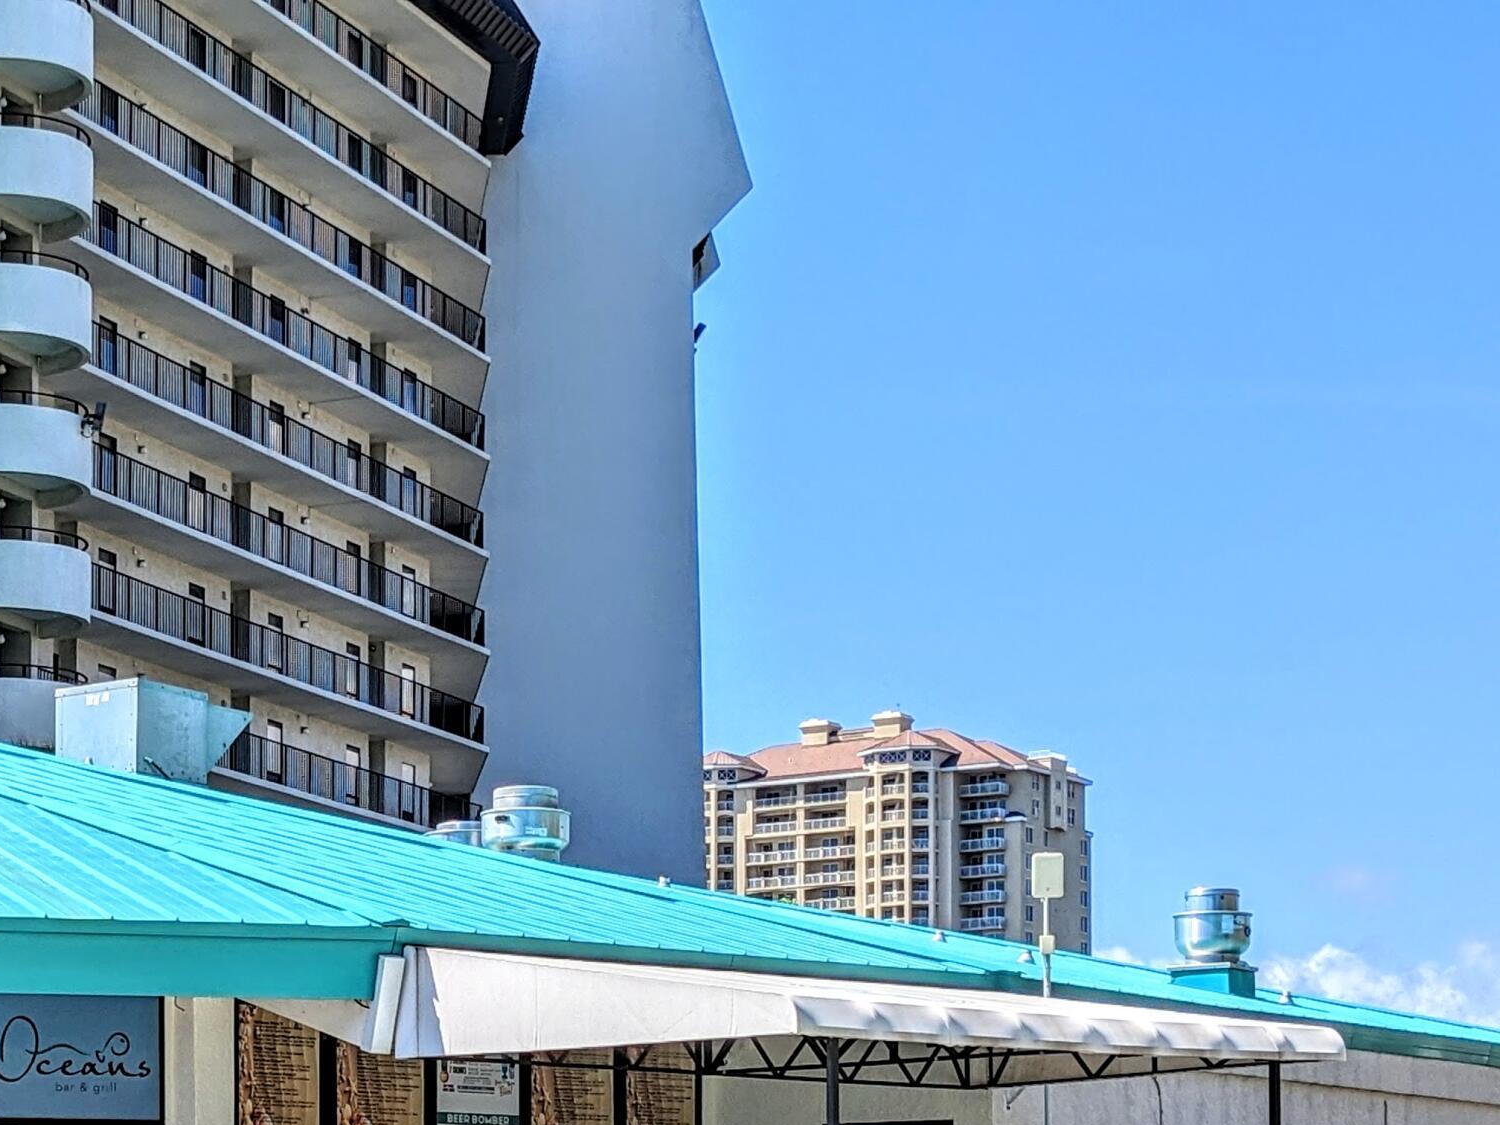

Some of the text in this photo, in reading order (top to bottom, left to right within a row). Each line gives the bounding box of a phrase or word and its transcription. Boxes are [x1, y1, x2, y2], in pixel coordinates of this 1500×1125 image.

[54, 1081, 118, 1095] bar & grill
[446, 1113, 510, 1125] BEER BOMBER
